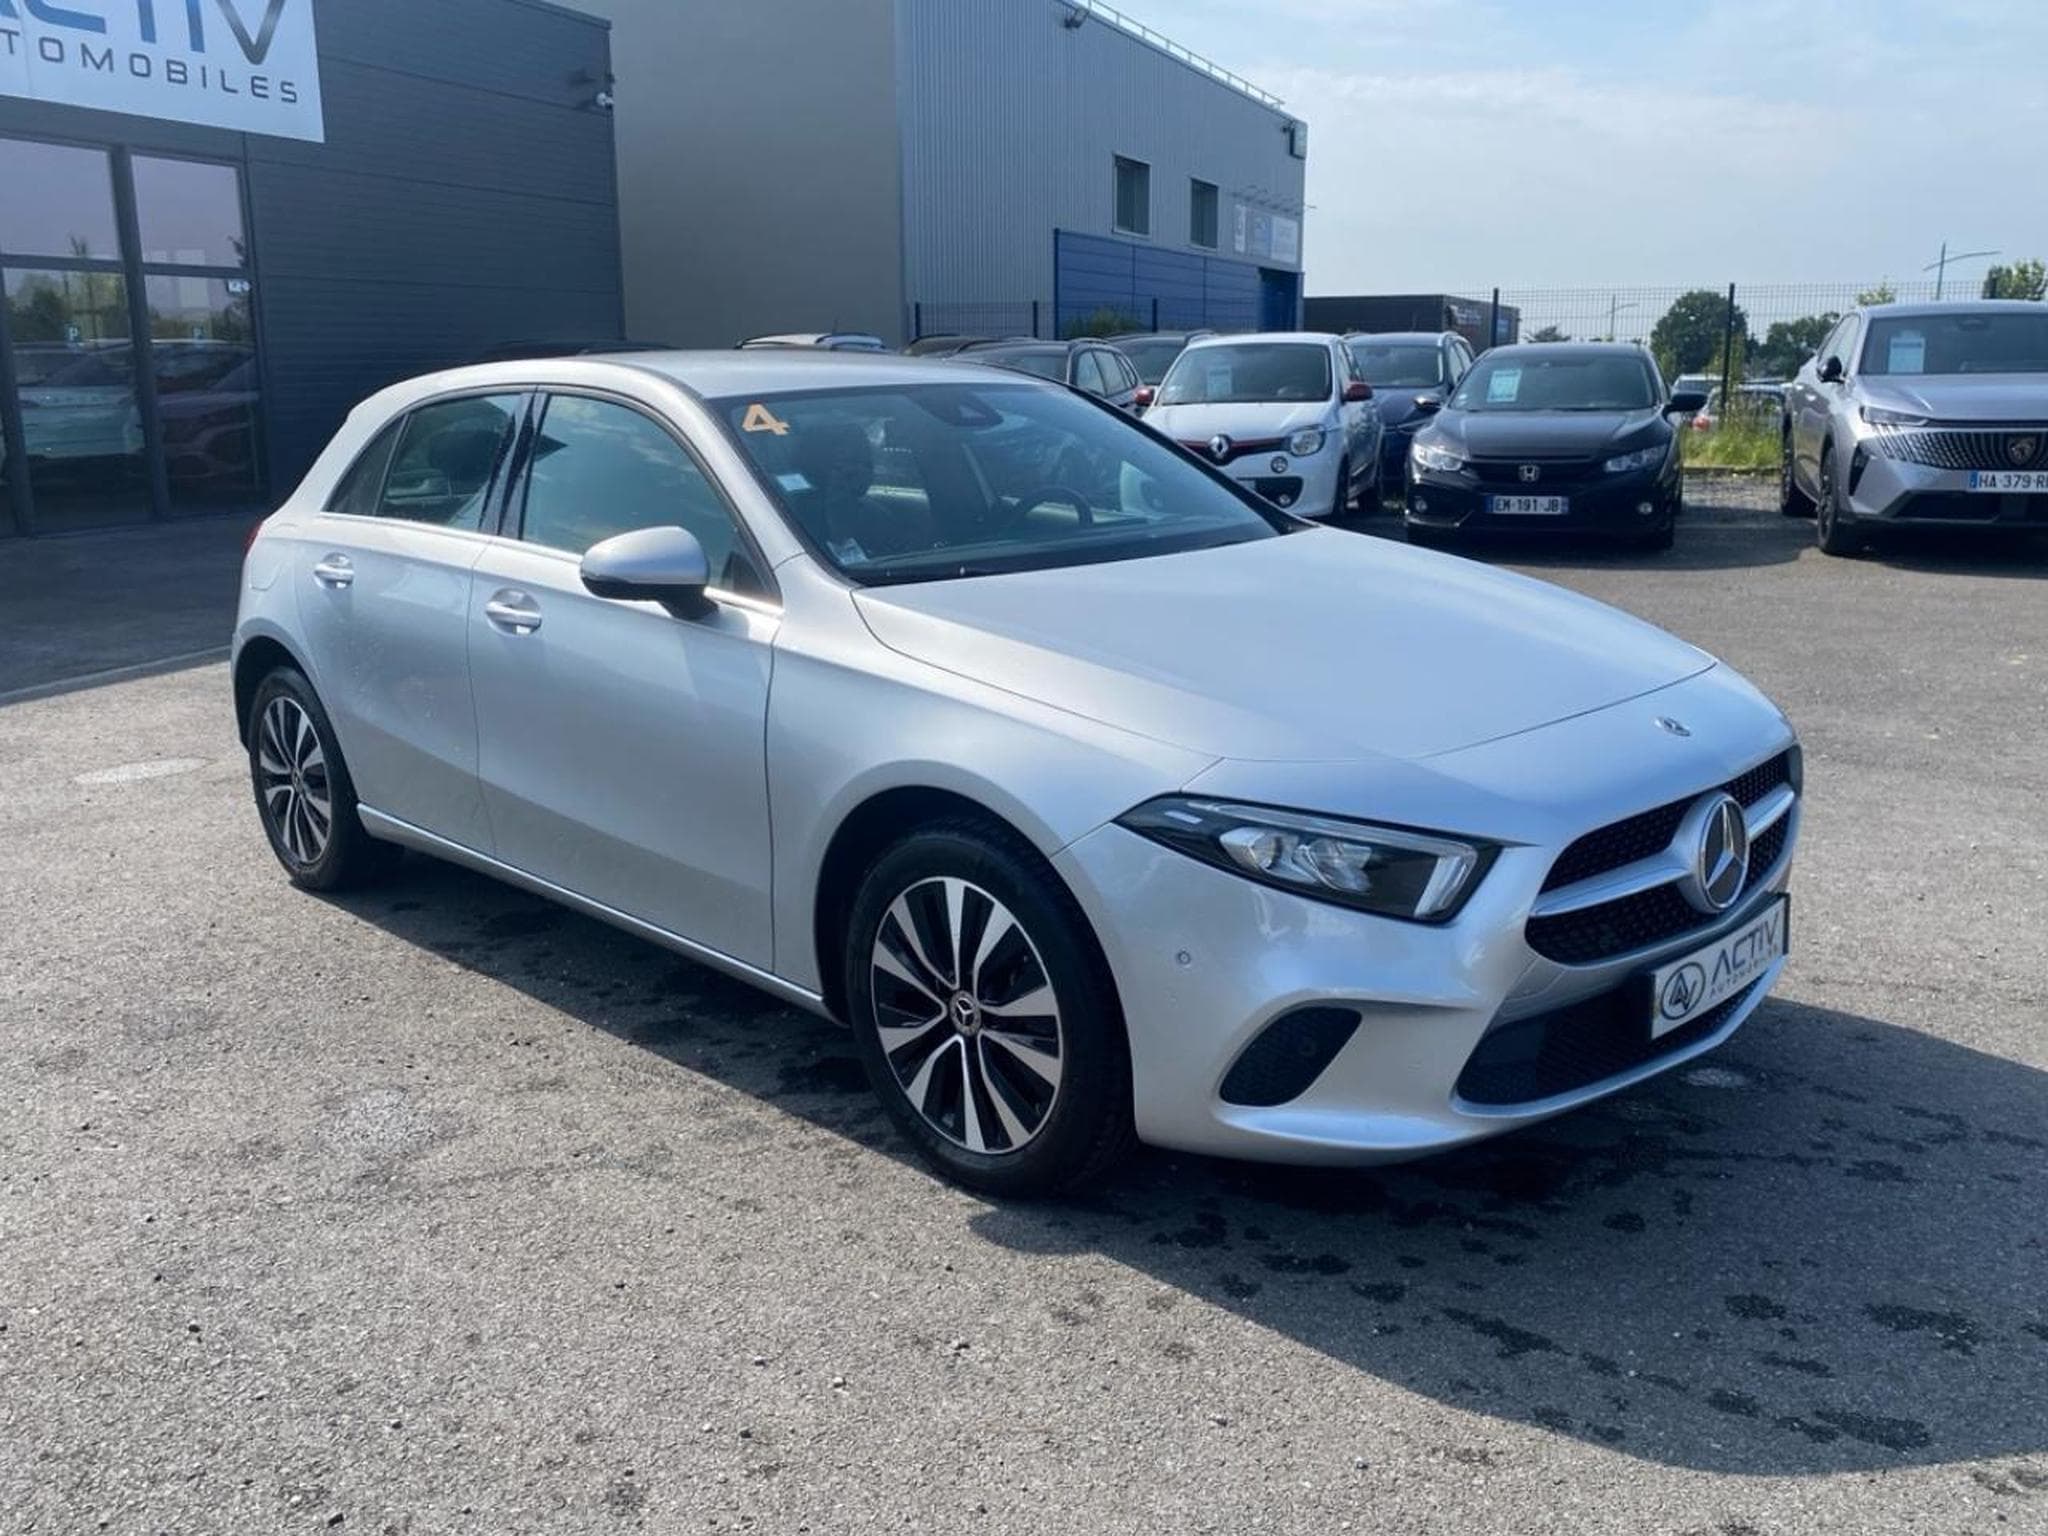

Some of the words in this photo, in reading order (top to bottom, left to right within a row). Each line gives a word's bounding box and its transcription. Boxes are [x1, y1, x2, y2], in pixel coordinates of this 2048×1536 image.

[0, 0, 286, 66] TIV
[742, 404, 789, 436] 4
[1979, 474, 2048, 489] HA-379-R
[1711, 911, 1779, 985] ACTIV
